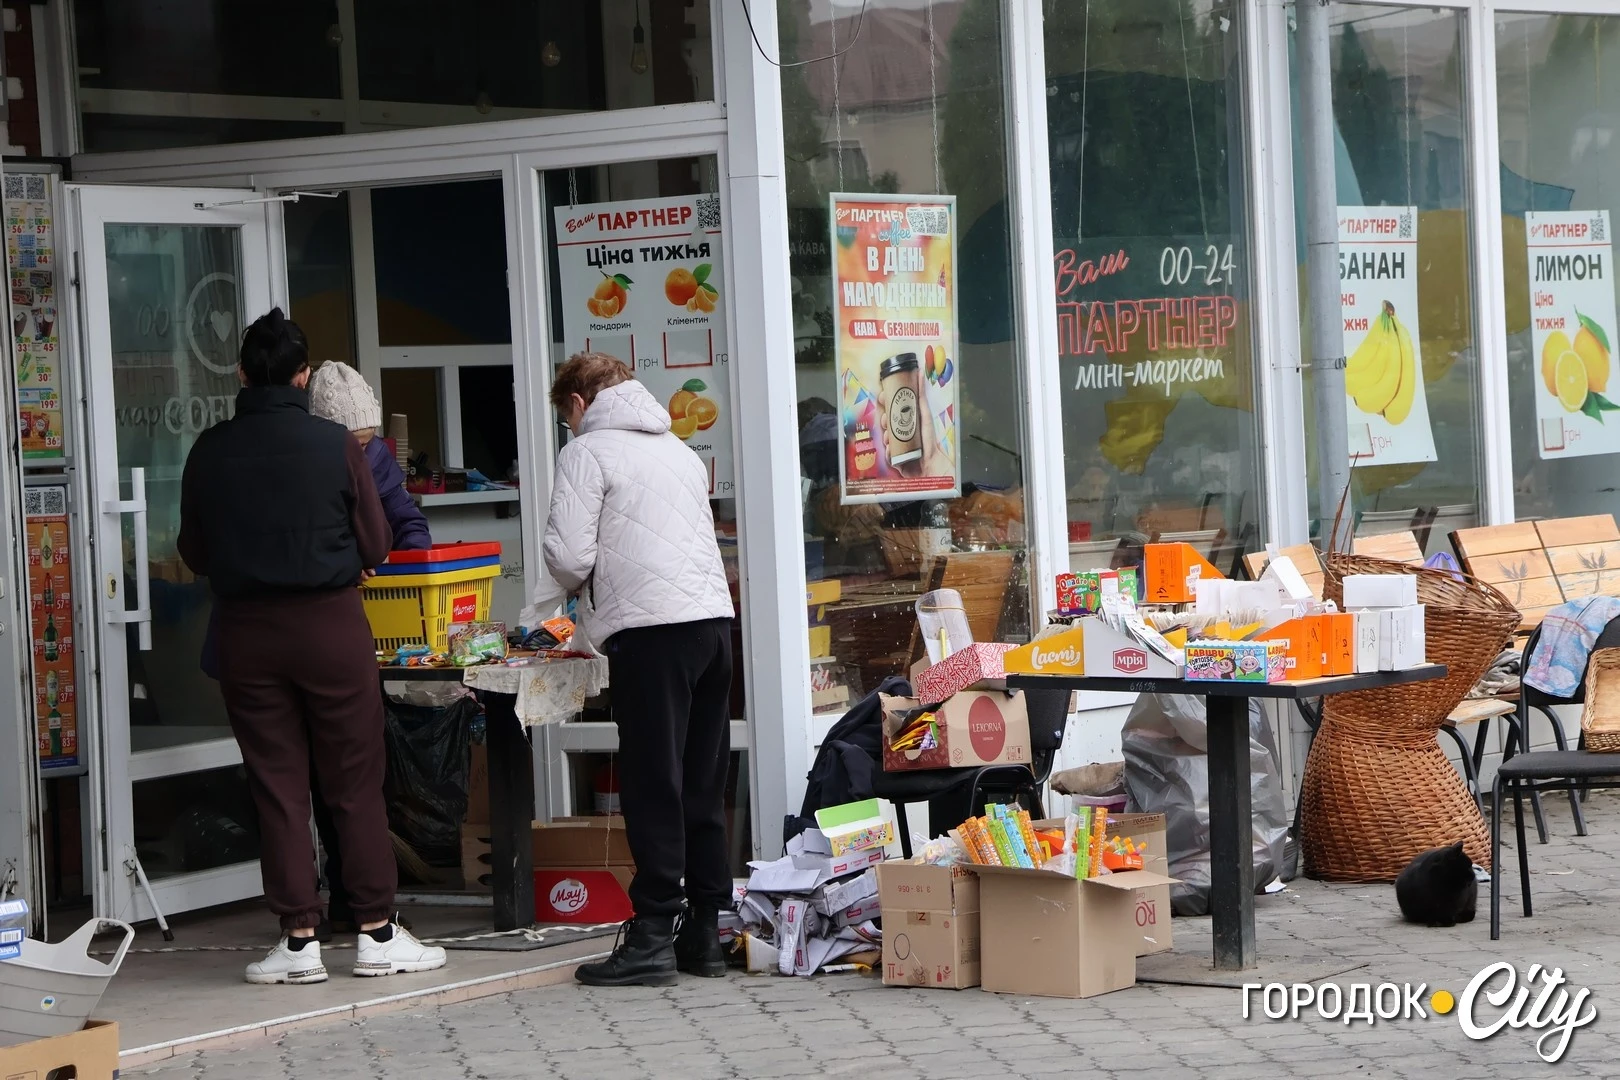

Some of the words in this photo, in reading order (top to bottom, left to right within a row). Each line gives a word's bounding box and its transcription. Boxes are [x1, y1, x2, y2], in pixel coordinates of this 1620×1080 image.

[565, 212, 596, 233] Ваш
[597, 206, 692, 231] ПАРТНЕР
[851, 208, 904, 223] ПАРТНЕР
[878, 220, 912, 247] coffee
[1347, 218, 1397, 234] ПАРТНЕР
[1543, 223, 1588, 238] ПАРТНЕР
[586, 244, 634, 269] Ціна
[639, 242, 711, 262] тижня
[867, 246, 879, 272] В
[883, 246, 925, 276] ДЕНЬ
[1054, 249, 1130, 296] Ваш
[1159, 244, 1237, 286] 00-24
[1339, 251, 1405, 280] БАНАН
[1535, 254, 1603, 282] ЛИМОН
[843, 281, 947, 312] НАРОДЖЕННЯ
[1341, 293, 1356, 306] на
[1534, 289, 1554, 309] Ціна
[589, 321, 632, 332] Мандарин
[666, 316, 709, 326] Кліментин
[854, 321, 877, 336] КАВА
[1055, 295, 1239, 356] ПАРТНЕР
[1343, 318, 1369, 331] жня
[1535, 317, 1566, 330] тижня
[638, 357, 658, 370] грн
[716, 352, 729, 366] гр
[1060, 577, 1089, 592] Quadro
[1116, 652, 1144, 669] мрія
[1187, 648, 1225, 658] LABUBU
[972, 722, 1003, 733] LEKORNA
[552, 885, 586, 908] Мяу!
